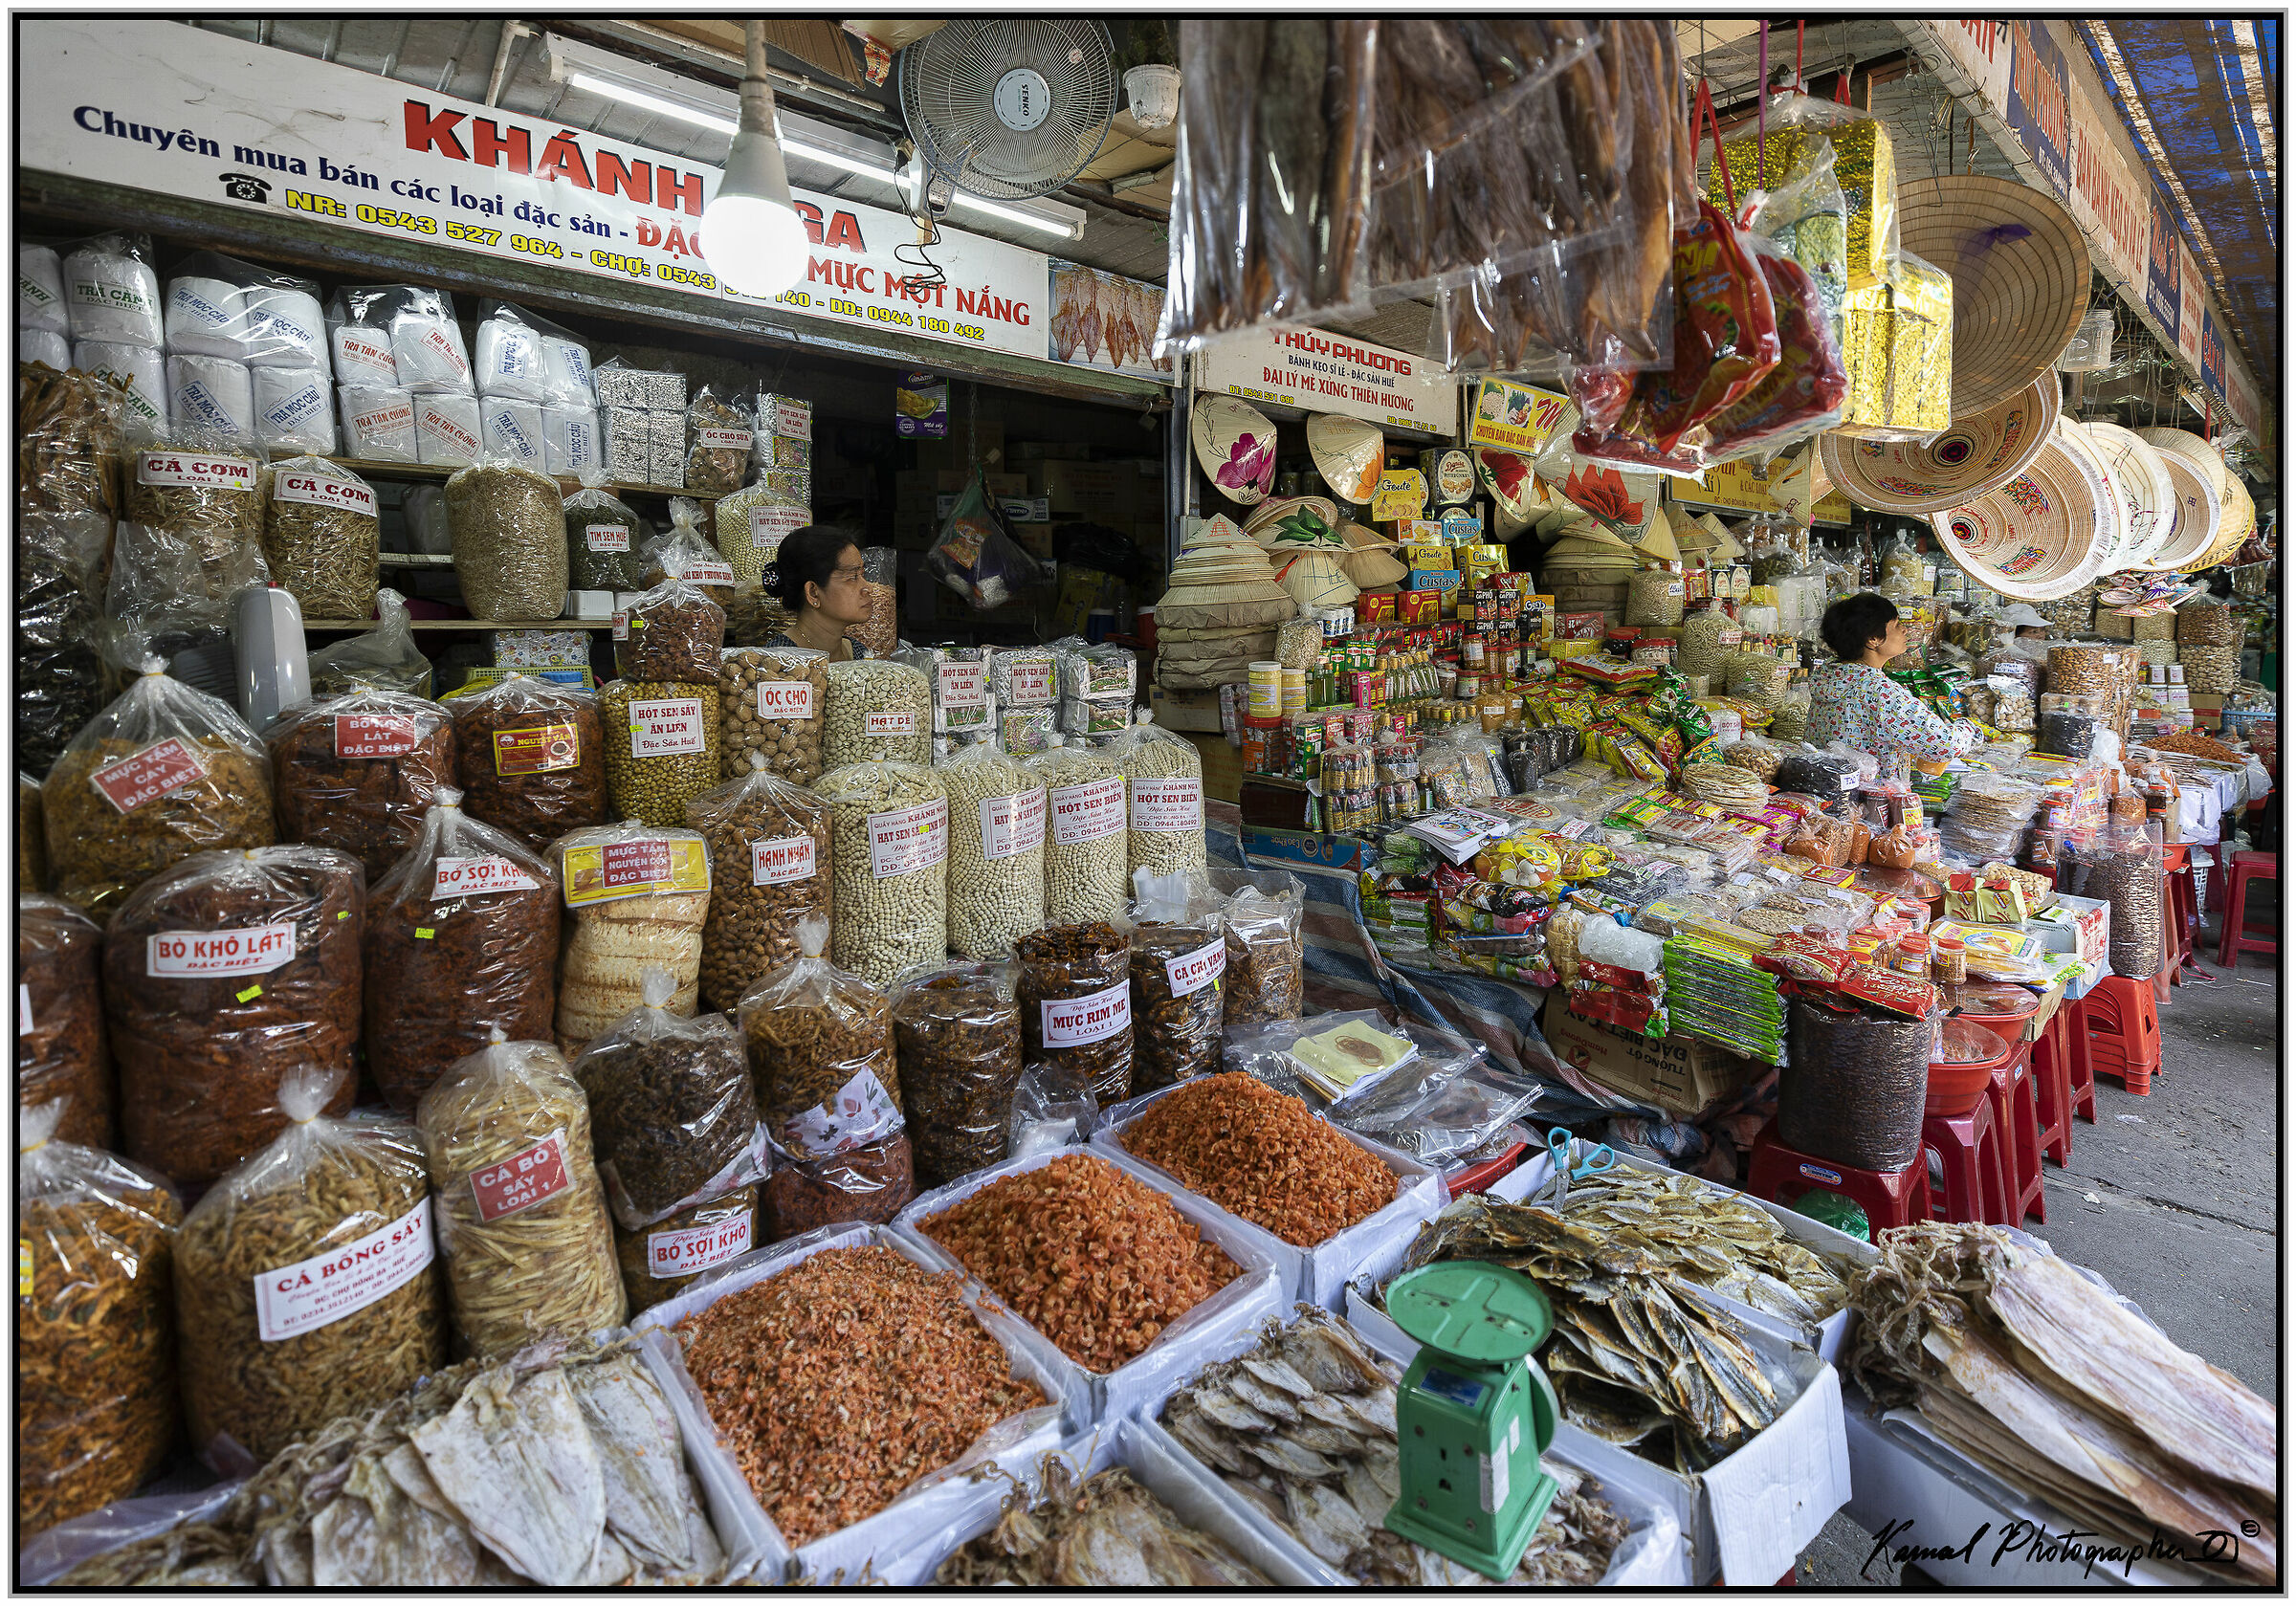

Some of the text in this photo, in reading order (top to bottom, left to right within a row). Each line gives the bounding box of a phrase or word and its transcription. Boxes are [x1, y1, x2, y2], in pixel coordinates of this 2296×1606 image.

[1020, 83, 1030, 117] SENKO
[404, 99, 704, 218] KHÁNH
[73, 105, 221, 159] Chuyên
[232, 143, 308, 176] mua
[318, 156, 380, 191] bán
[390, 178, 440, 204] các
[450, 184, 504, 218] loại
[513, 199, 562, 230] đặc
[568, 213, 612, 238] sản
[807, 255, 875, 295] MỰC
[884, 271, 949, 310] MỘT
[956, 286, 1030, 326] NẮNG
[285, 188, 346, 218] NR:
[356, 204, 437, 236] 0543
[446, 220, 502, 247] 527
[510, 233, 563, 259] 964
[589, 249, 651, 278] CHỢ:
[656, 264, 718, 291] 0543
[829, 297, 863, 319] DĐ:
[867, 307, 914, 327] 0944
[918, 315, 949, 335] 180
[954, 321, 986, 341] 492
[1288, 353, 1311, 370] BÁNH
[1312, 359, 1329, 375] KẸO
[1351, 368, 1366, 384] ĐẶC
[1381, 374, 1395, 388] HUẾ
[1243, 386, 1262, 400] 0543
[1264, 390, 1279, 403] 531
[1279, 393, 1295, 406] 698
[1263, 365, 1284, 388] ĐẠI
[1286, 368, 1298, 388] LÝ
[1300, 372, 1316, 392] MÈ
[1350, 383, 1379, 407] THIÊN
[1380, 390, 1415, 412] HƯƠNG
[146, 456, 249, 479] CÁ CƠM
[287, 476, 371, 505] CÁ CƠM
[589, 530, 602, 542] TIM
[602, 530, 617, 543] SEN
[1447, 522, 1478, 536] Custas
[1419, 575, 1456, 587] Custas
[954, 668, 967, 677] SEN
[1025, 667, 1038, 677] SEN
[765, 685, 807, 707] ÓC CHÓ
[638, 705, 659, 722] HỘT
[660, 707, 679, 718] SEN
[364, 730, 392, 741] LÁT
[343, 744, 374, 756] ĐẶC
[134, 764, 169, 785] CAY
[122, 766, 198, 808] ĐẶC BIỆT
[1162, 781, 1187, 792] KHÁNH
[994, 814, 1009, 828] HẠT
[877, 827, 911, 847] HẠT SEN
[759, 842, 811, 870] HẠNH NHÂN
[460, 879, 518, 891] ĐẶC BIỆT
[608, 868, 668, 884] ĐẶC BIỆT
[158, 930, 286, 959] BÒ KHÔ LÁT
[219, 957, 263, 969] BIỆT
[1052, 1002, 1126, 1033] MỰC RIM ME
[1075, 1023, 1106, 1038] LOẠI
[479, 1167, 514, 1188] CÁ
[502, 1173, 536, 1197] SẤY
[496, 1180, 550, 1213] LOẠI 1
[276, 1269, 313, 1293] CÁ
[390, 1214, 424, 1245] SẤY
[656, 1224, 747, 1264] BÒ SỢI KHÔ
[679, 1247, 735, 1271] ĐẶC BIỆT
